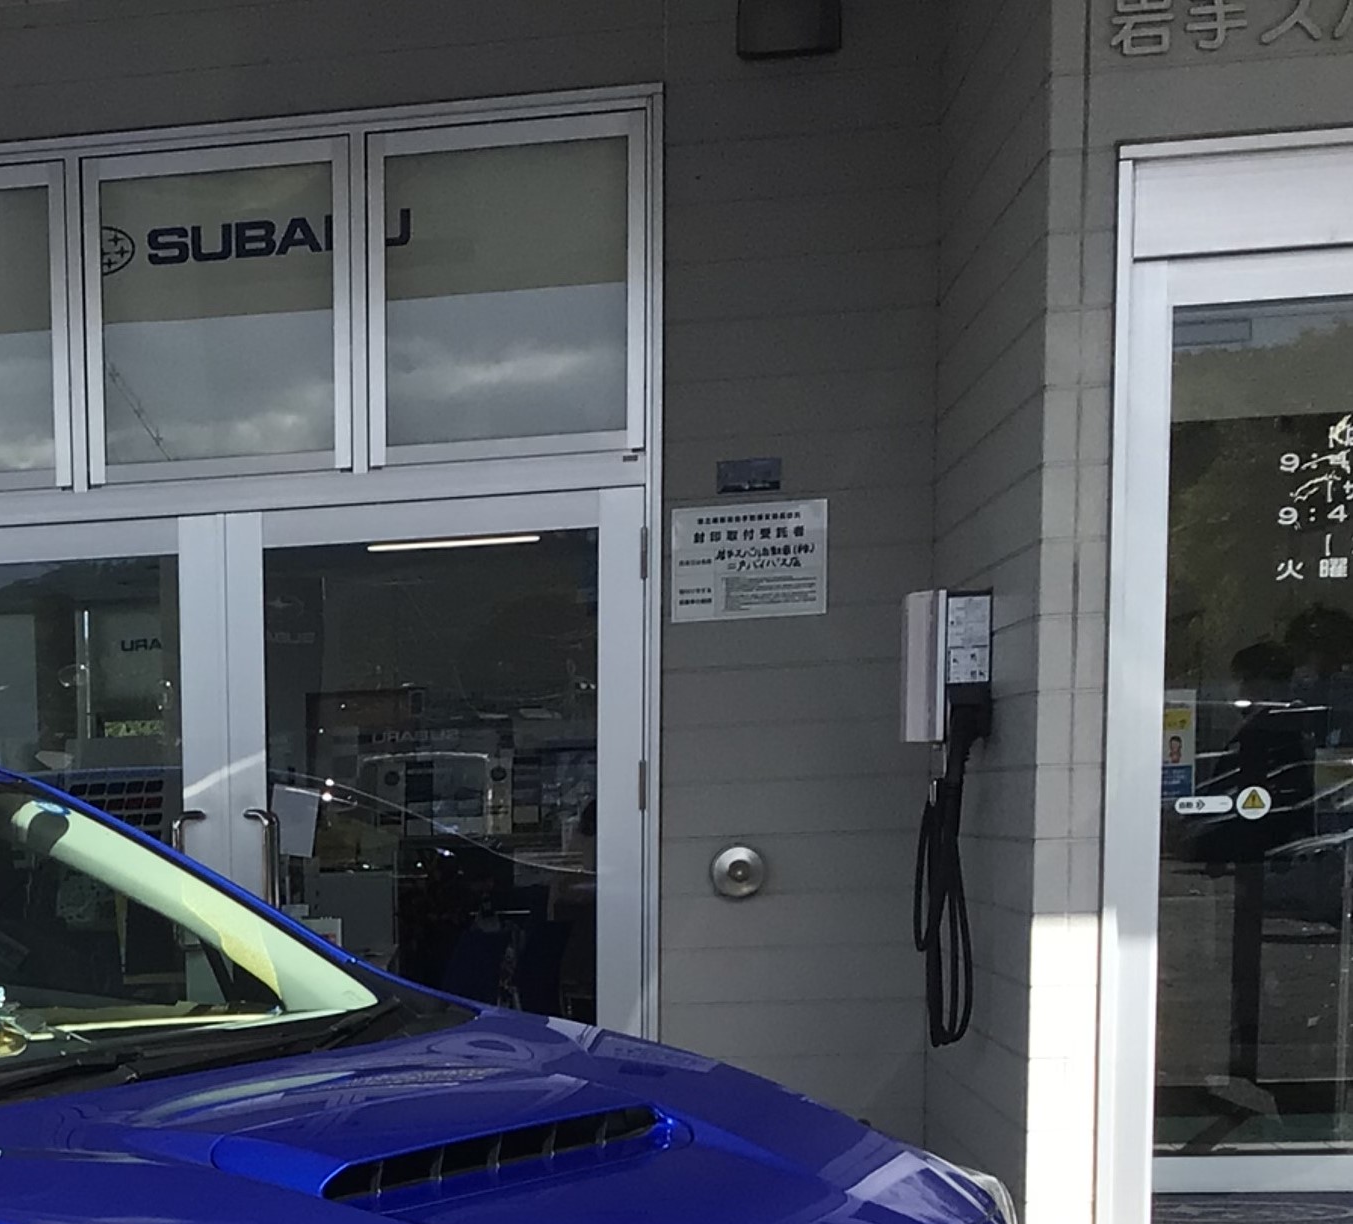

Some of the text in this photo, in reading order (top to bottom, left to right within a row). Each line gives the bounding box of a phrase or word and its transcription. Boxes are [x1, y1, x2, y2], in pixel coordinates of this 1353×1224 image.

[1110, 0, 1353, 56] 岩手ス
[147, 208, 410, 265] SUBAU
